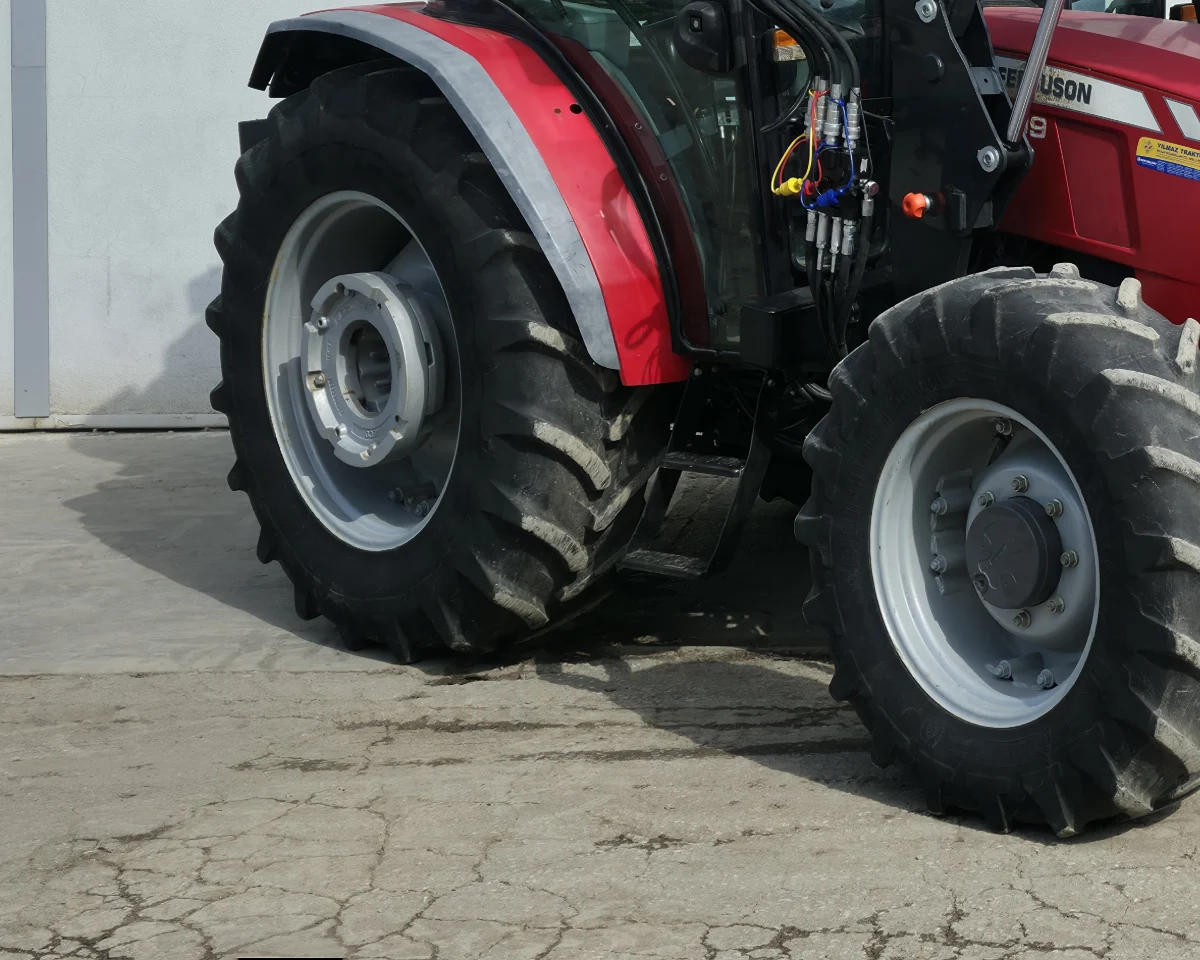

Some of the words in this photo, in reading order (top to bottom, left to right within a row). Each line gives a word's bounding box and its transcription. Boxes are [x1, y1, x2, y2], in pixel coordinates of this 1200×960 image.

[998, 66, 1092, 105] FEUSON
[1024, 115, 1047, 139] 9
[1157, 142, 1179, 153] YILMAZ
